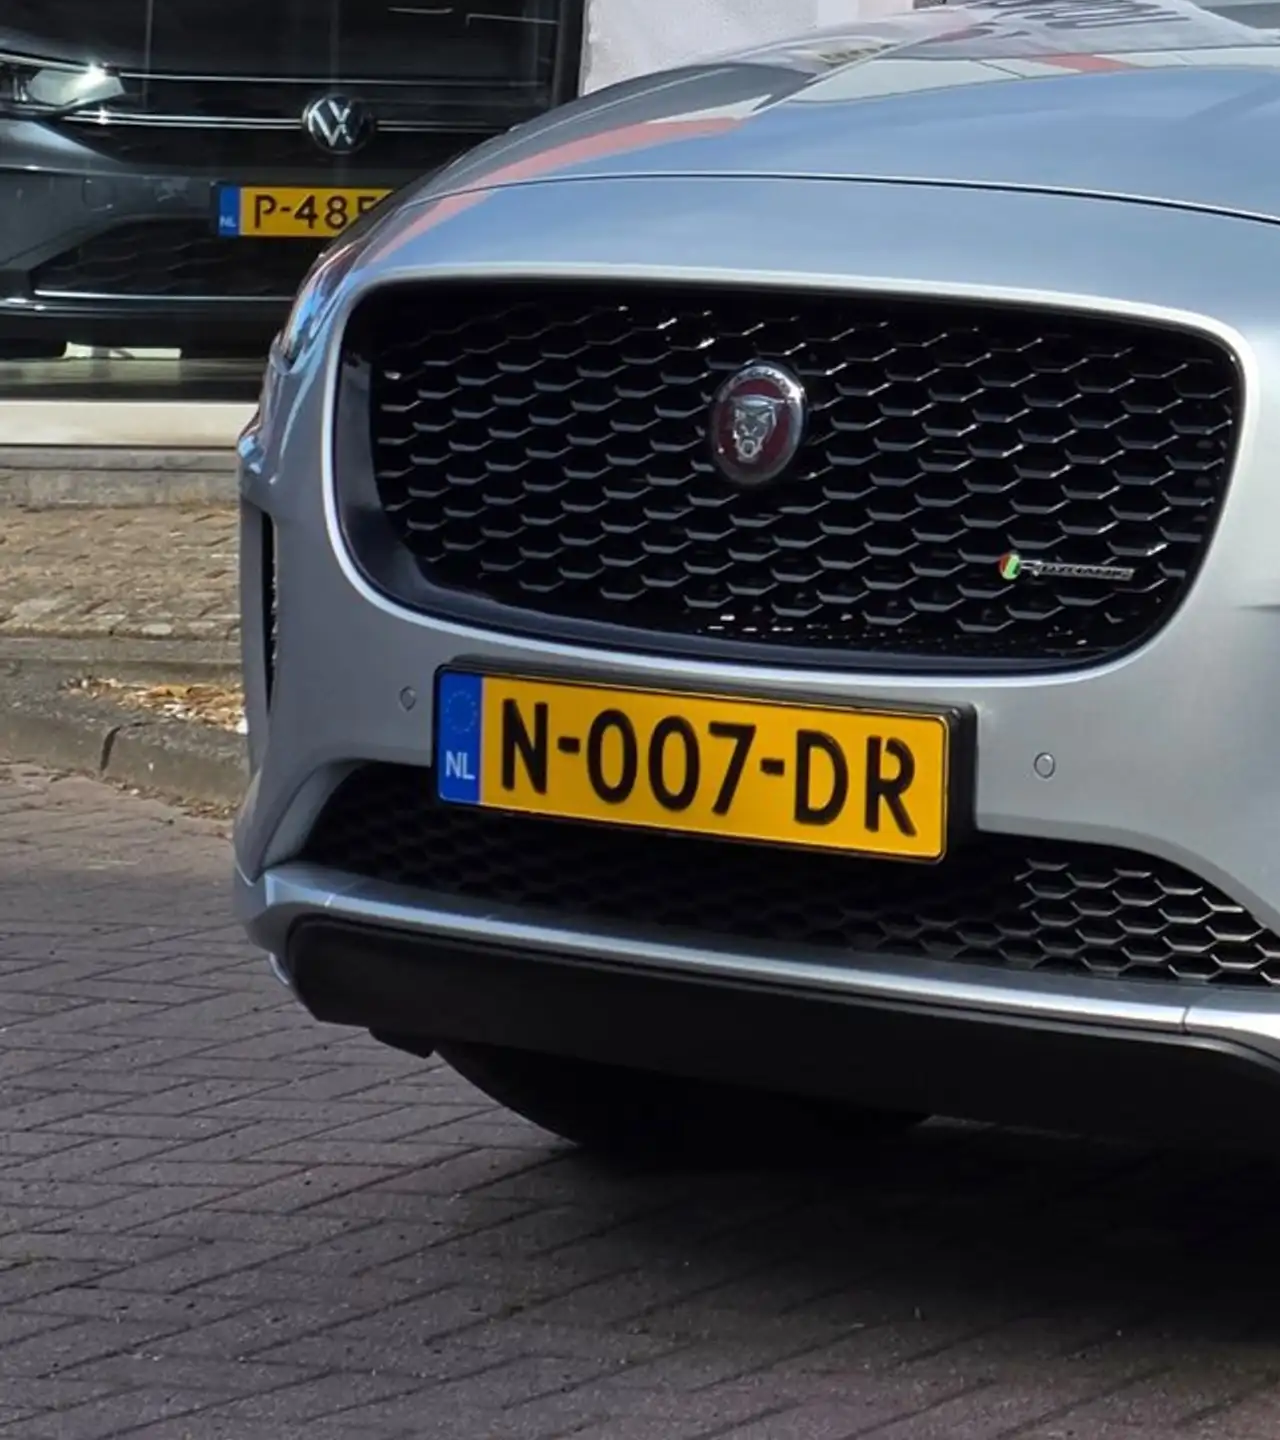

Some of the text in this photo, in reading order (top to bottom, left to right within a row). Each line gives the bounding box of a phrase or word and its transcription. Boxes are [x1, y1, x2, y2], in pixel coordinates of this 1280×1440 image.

[219, 215, 237, 228] NL
[445, 749, 476, 781] NL
[501, 698, 918, 838] N-007-DR
